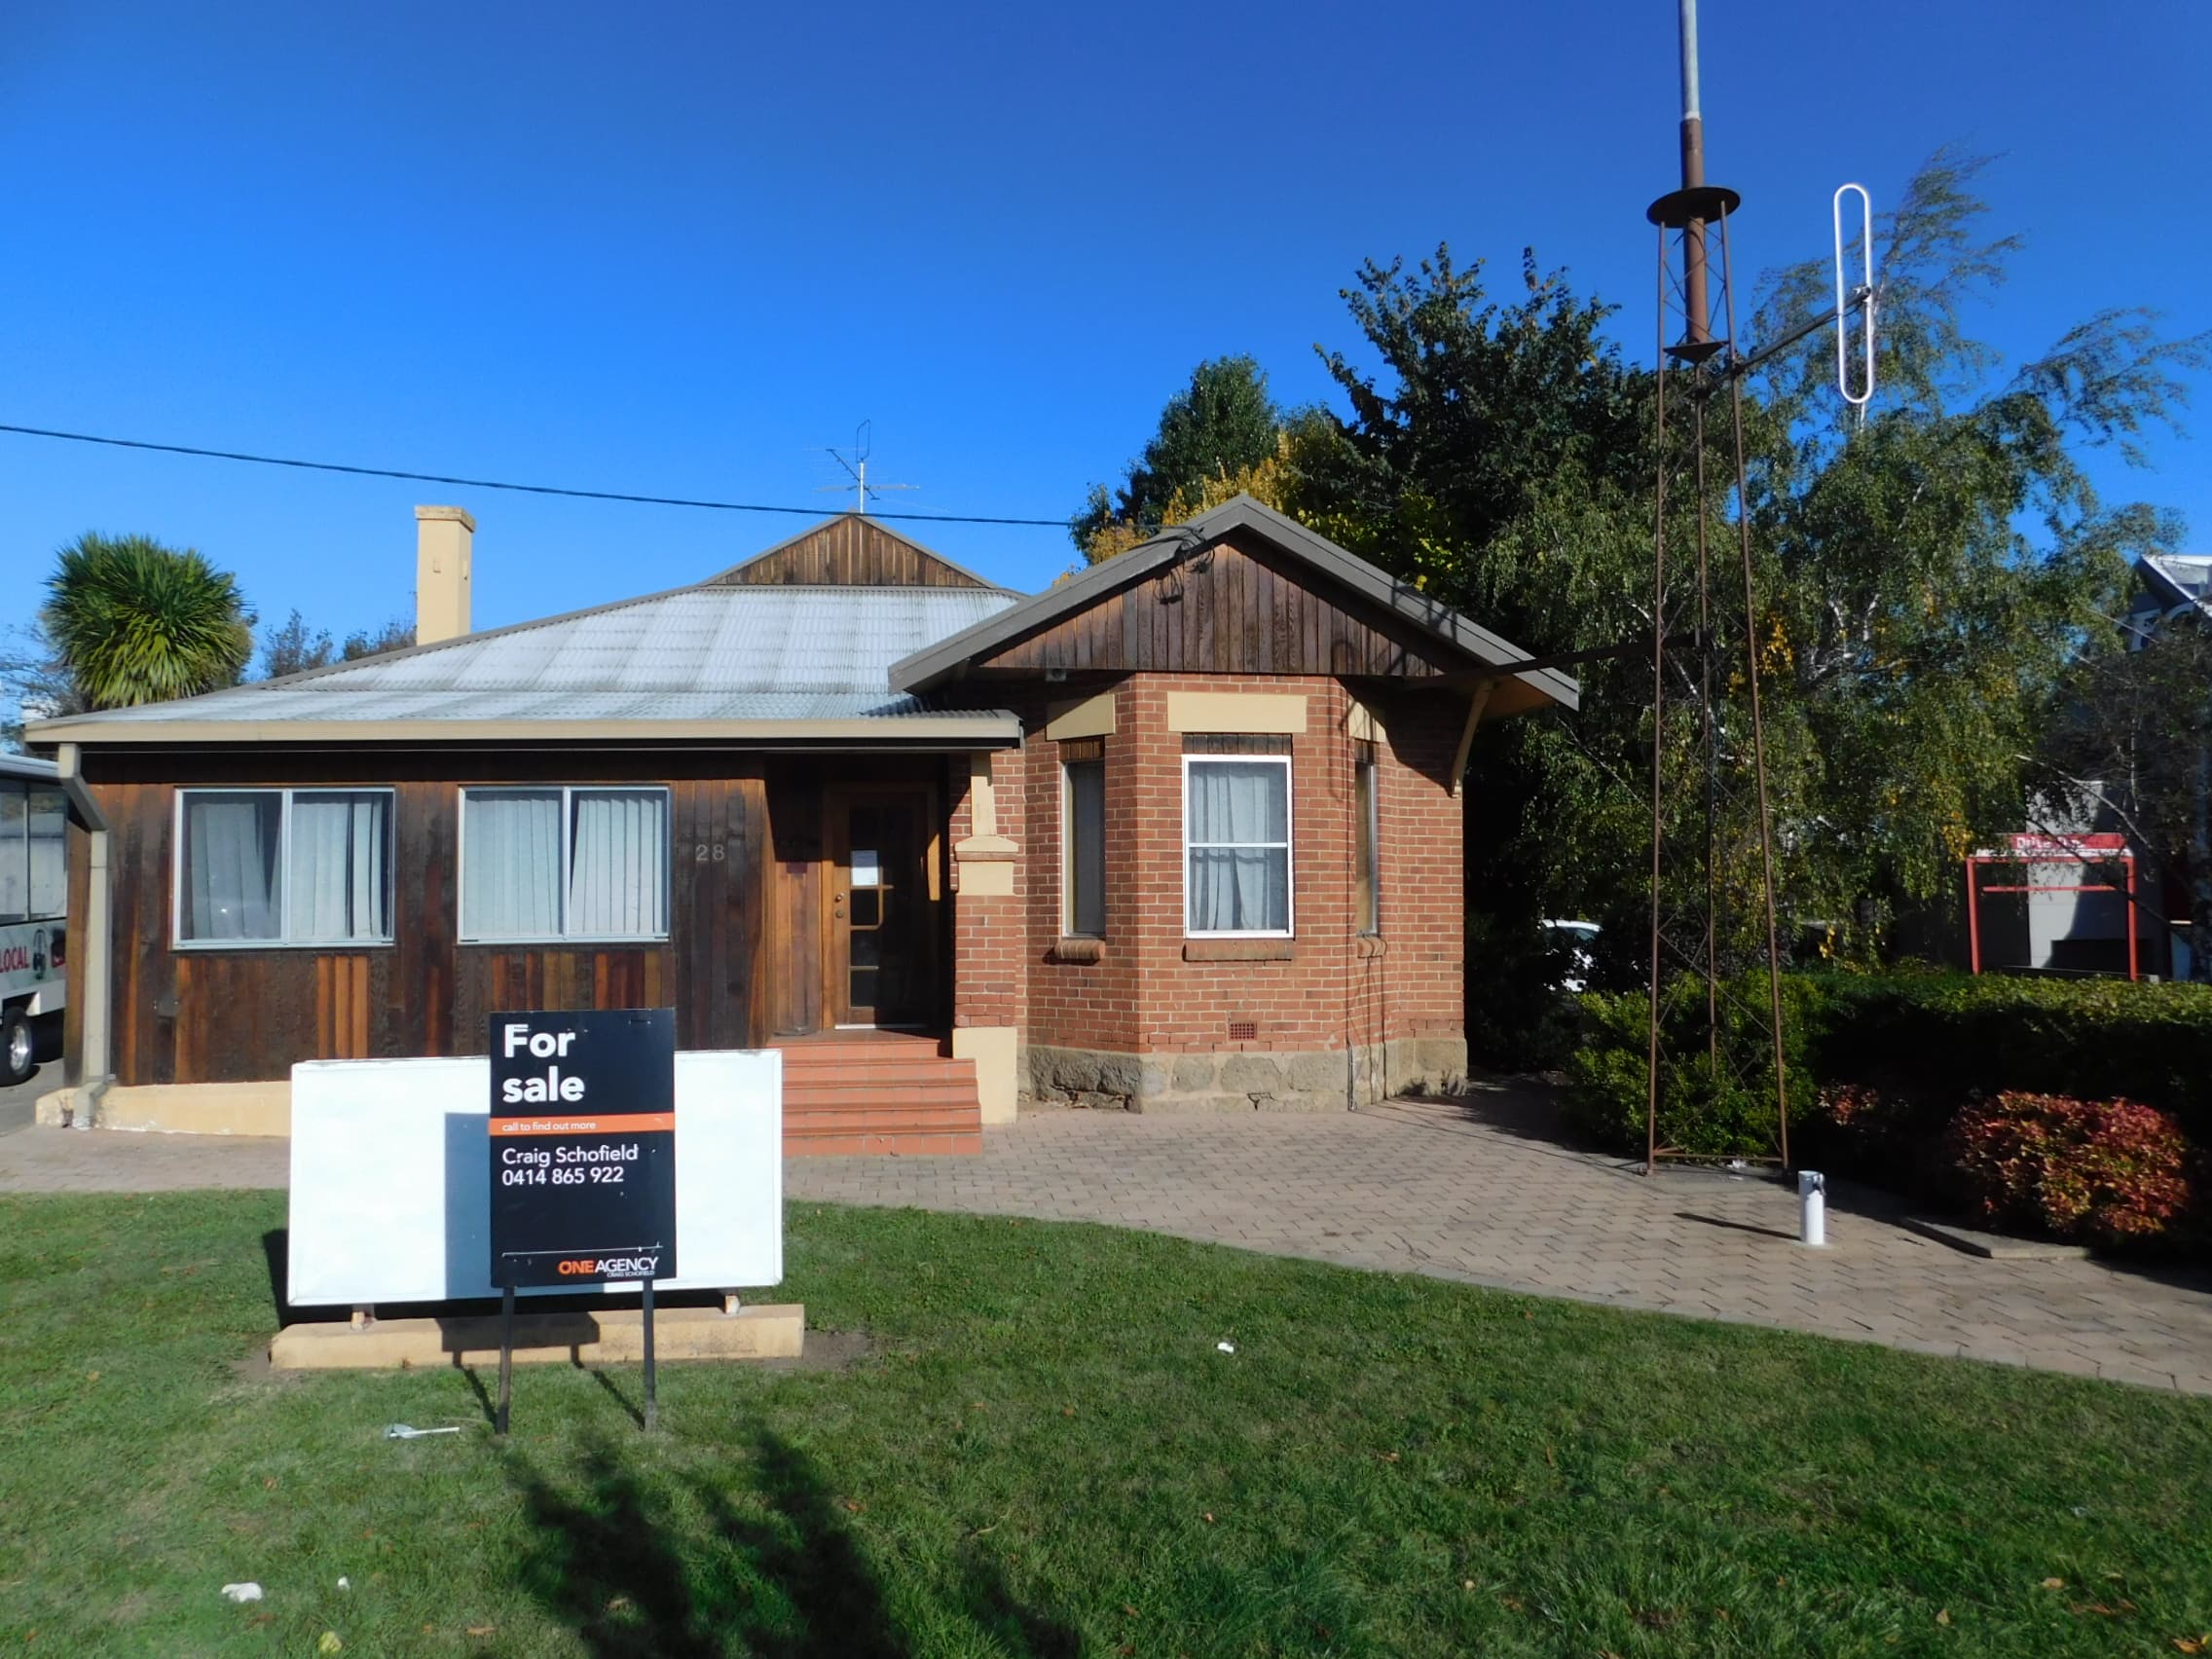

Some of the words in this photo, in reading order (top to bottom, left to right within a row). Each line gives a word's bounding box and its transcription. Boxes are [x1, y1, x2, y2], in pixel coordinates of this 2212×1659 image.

[695, 843, 725, 862] 28
[504, 1023, 576, 1058] For
[502, 1065, 585, 1103] sale
[502, 1122, 519, 1131] call
[520, 1123, 531, 1131] to
[533, 1122, 551, 1130] find
[552, 1122, 570, 1130] out
[571, 1122, 597, 1130] more
[502, 1148, 551, 1167] Craig
[555, 1144, 639, 1162] Schofield
[501, 1168, 547, 1186] 0414
[552, 1167, 585, 1184] 865
[590, 1166, 624, 1183] 922
